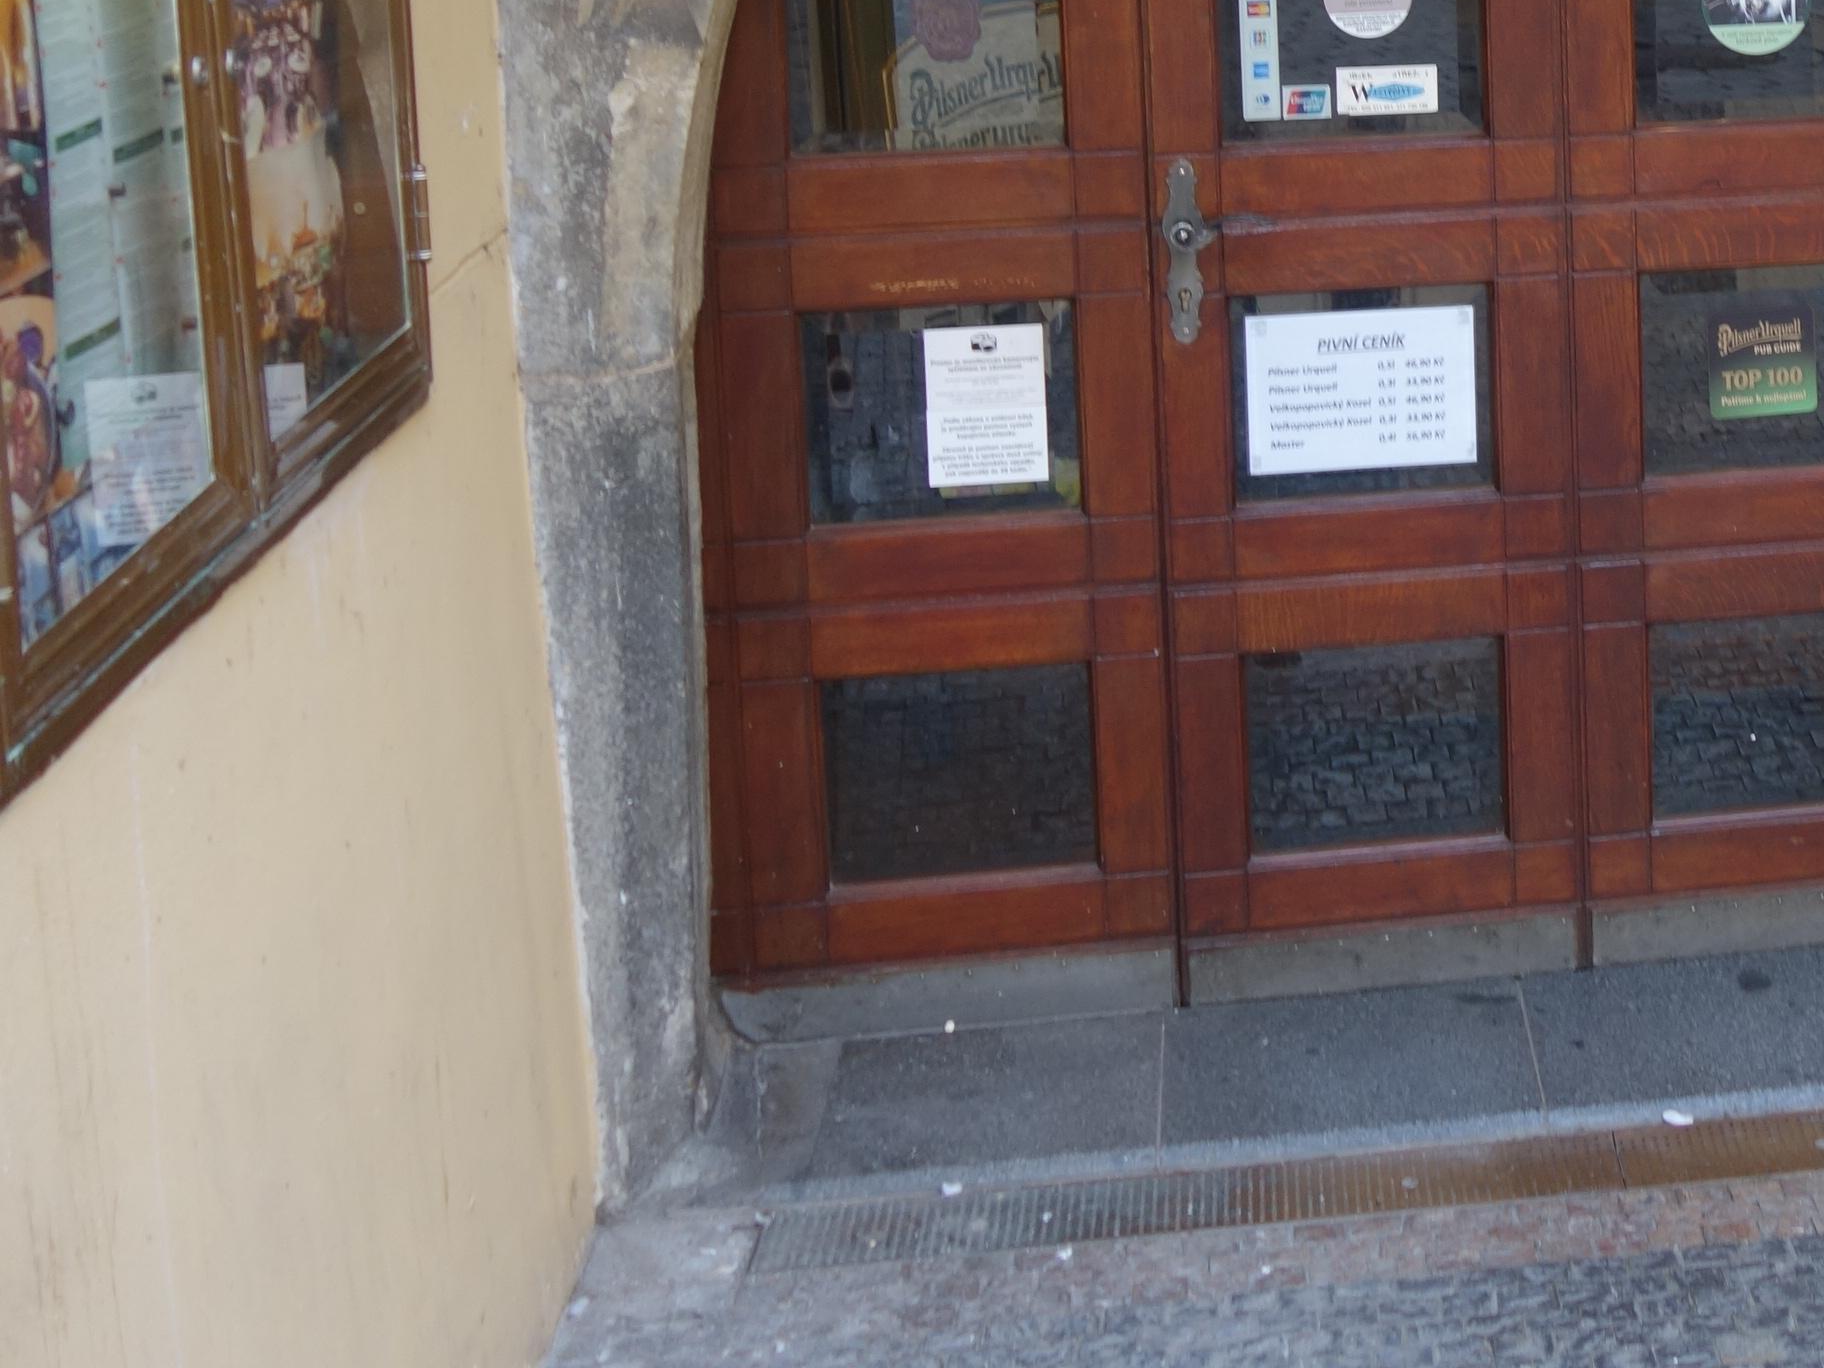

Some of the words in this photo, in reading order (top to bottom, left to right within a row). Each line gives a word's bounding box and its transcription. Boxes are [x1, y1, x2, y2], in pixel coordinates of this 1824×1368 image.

[1316, 334, 1358, 353] PIVNÍ
[1361, 331, 1407, 350] CENÍK
[1718, 323, 1760, 358] Pilsner
[1759, 318, 1801, 344] Urquell
[1721, 368, 1762, 391] TOP
[1767, 366, 1803, 388] 100
